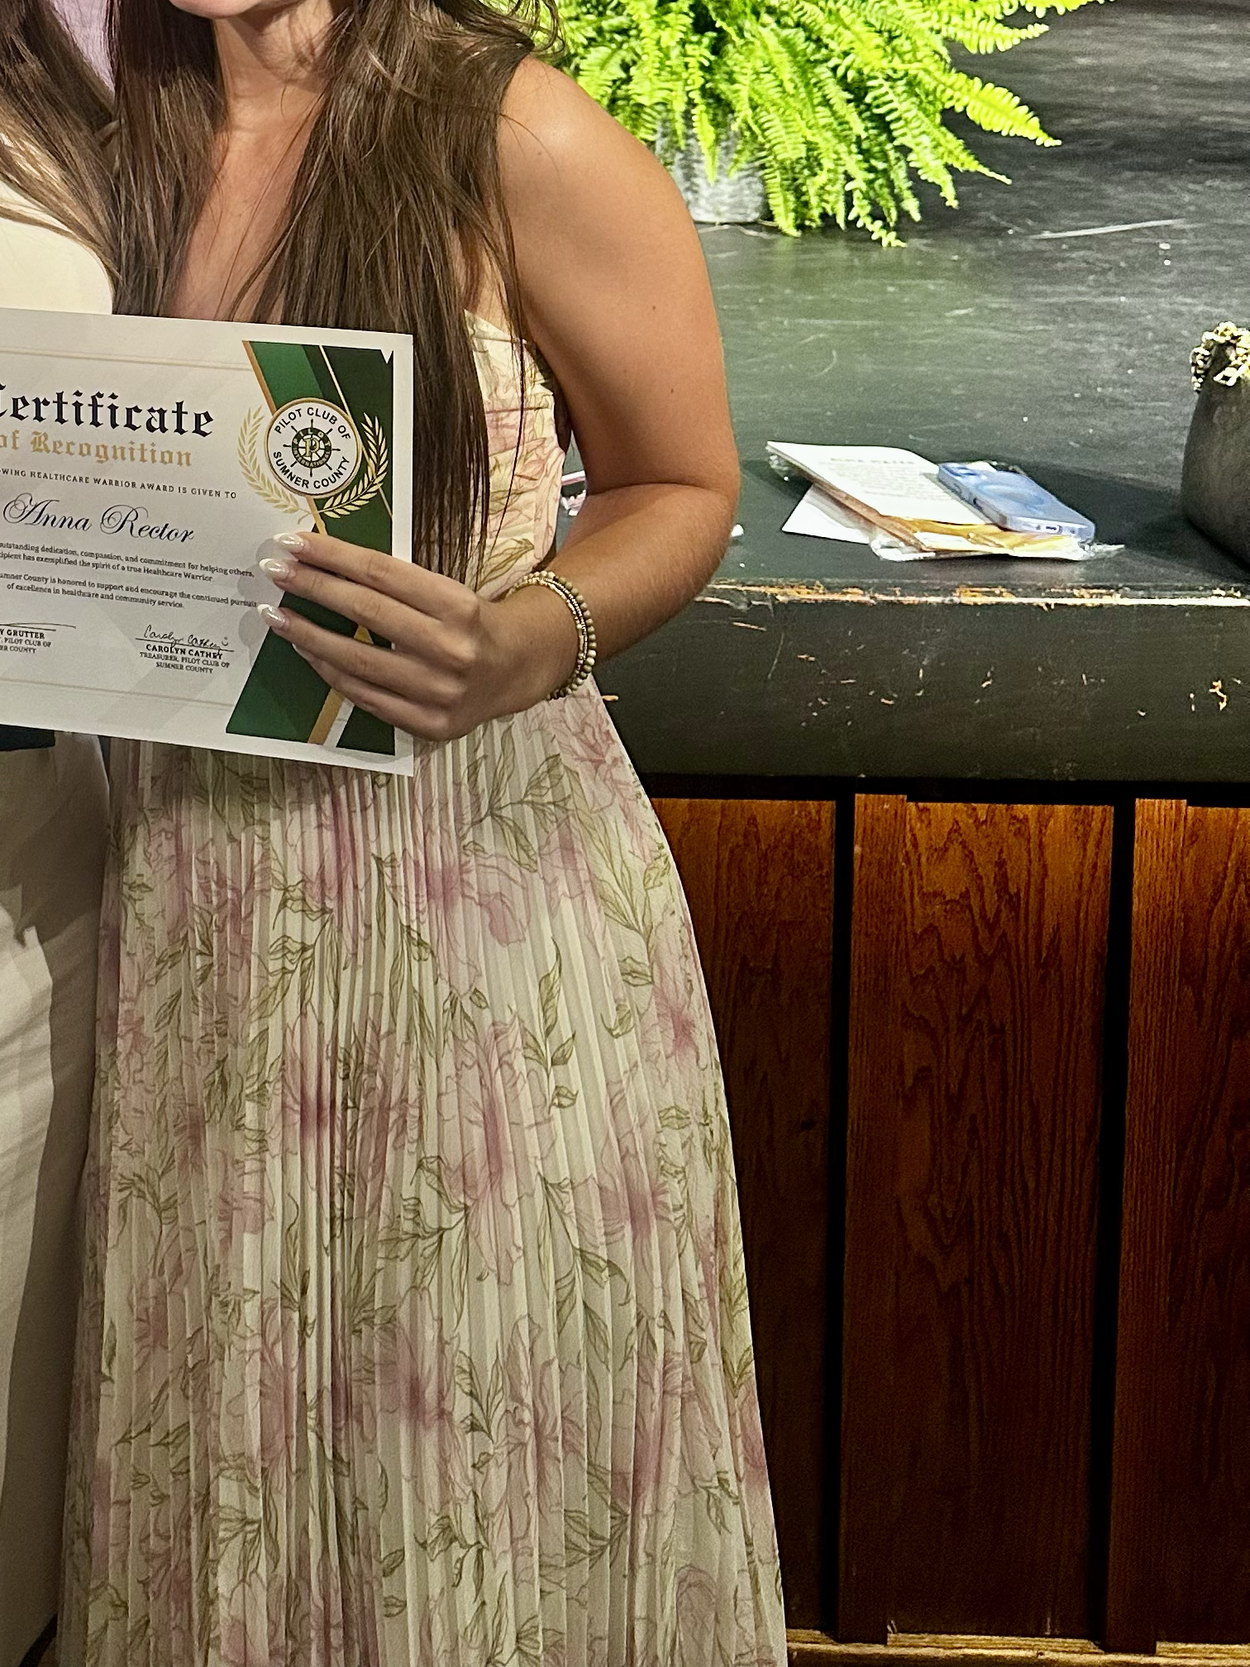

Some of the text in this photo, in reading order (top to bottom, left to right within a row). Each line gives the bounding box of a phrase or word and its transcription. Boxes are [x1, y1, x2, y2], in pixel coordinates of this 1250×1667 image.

[274, 407, 351, 440] PILOT CLUB OF
[30, 430, 192, 467] Recognition
[273, 452, 350, 489] SUMNER COUNTY
[30, 470, 90, 484] HEALTHCARE
[93, 477, 137, 489] WARRIOR
[140, 482, 174, 493] AWARD
[178, 486, 187, 494] IS
[191, 488, 221, 498] GIVEN
[225, 491, 237, 499] TO
[2, 492, 195, 544] Anna Rector
[22, 554, 35, 562] has
[36, 556, 77, 566] exemplified
[79, 559, 90, 567] the
[92, 562, 110, 570] spirit
[143, 566, 182, 578] Healthcare
[184, 571, 213, 582] Warrior
[125, 555, 138, 563] and
[140, 557, 186, 569] commitment
[188, 562, 199, 570] for
[200, 564, 228, 575] helping
[16, 584, 51, 594] excellence
[62, 588, 99, 599] healthcare
[115, 595, 156, 606] community
[23, 574, 49, 584] County
[58, 577, 87, 587] honored
[97, 583, 124, 591] support
[140, 588, 177, 598] encourage
[179, 591, 190, 599] the
[192, 593, 228, 604] continued
[230, 599, 257, 607] pursuit
[4, 637, 23, 645] PILOT
[25, 639, 41, 647] CLUB
[6, 629, 45, 639] GRUTTER
[10, 646, 36, 654] COUNTY
[146, 644, 223, 660] CAROLYN CATHEY
[156, 662, 214, 674] SUMNER COUNTY
[181, 656, 200, 665] PILOT
[202, 659, 219, 667] CLUB
